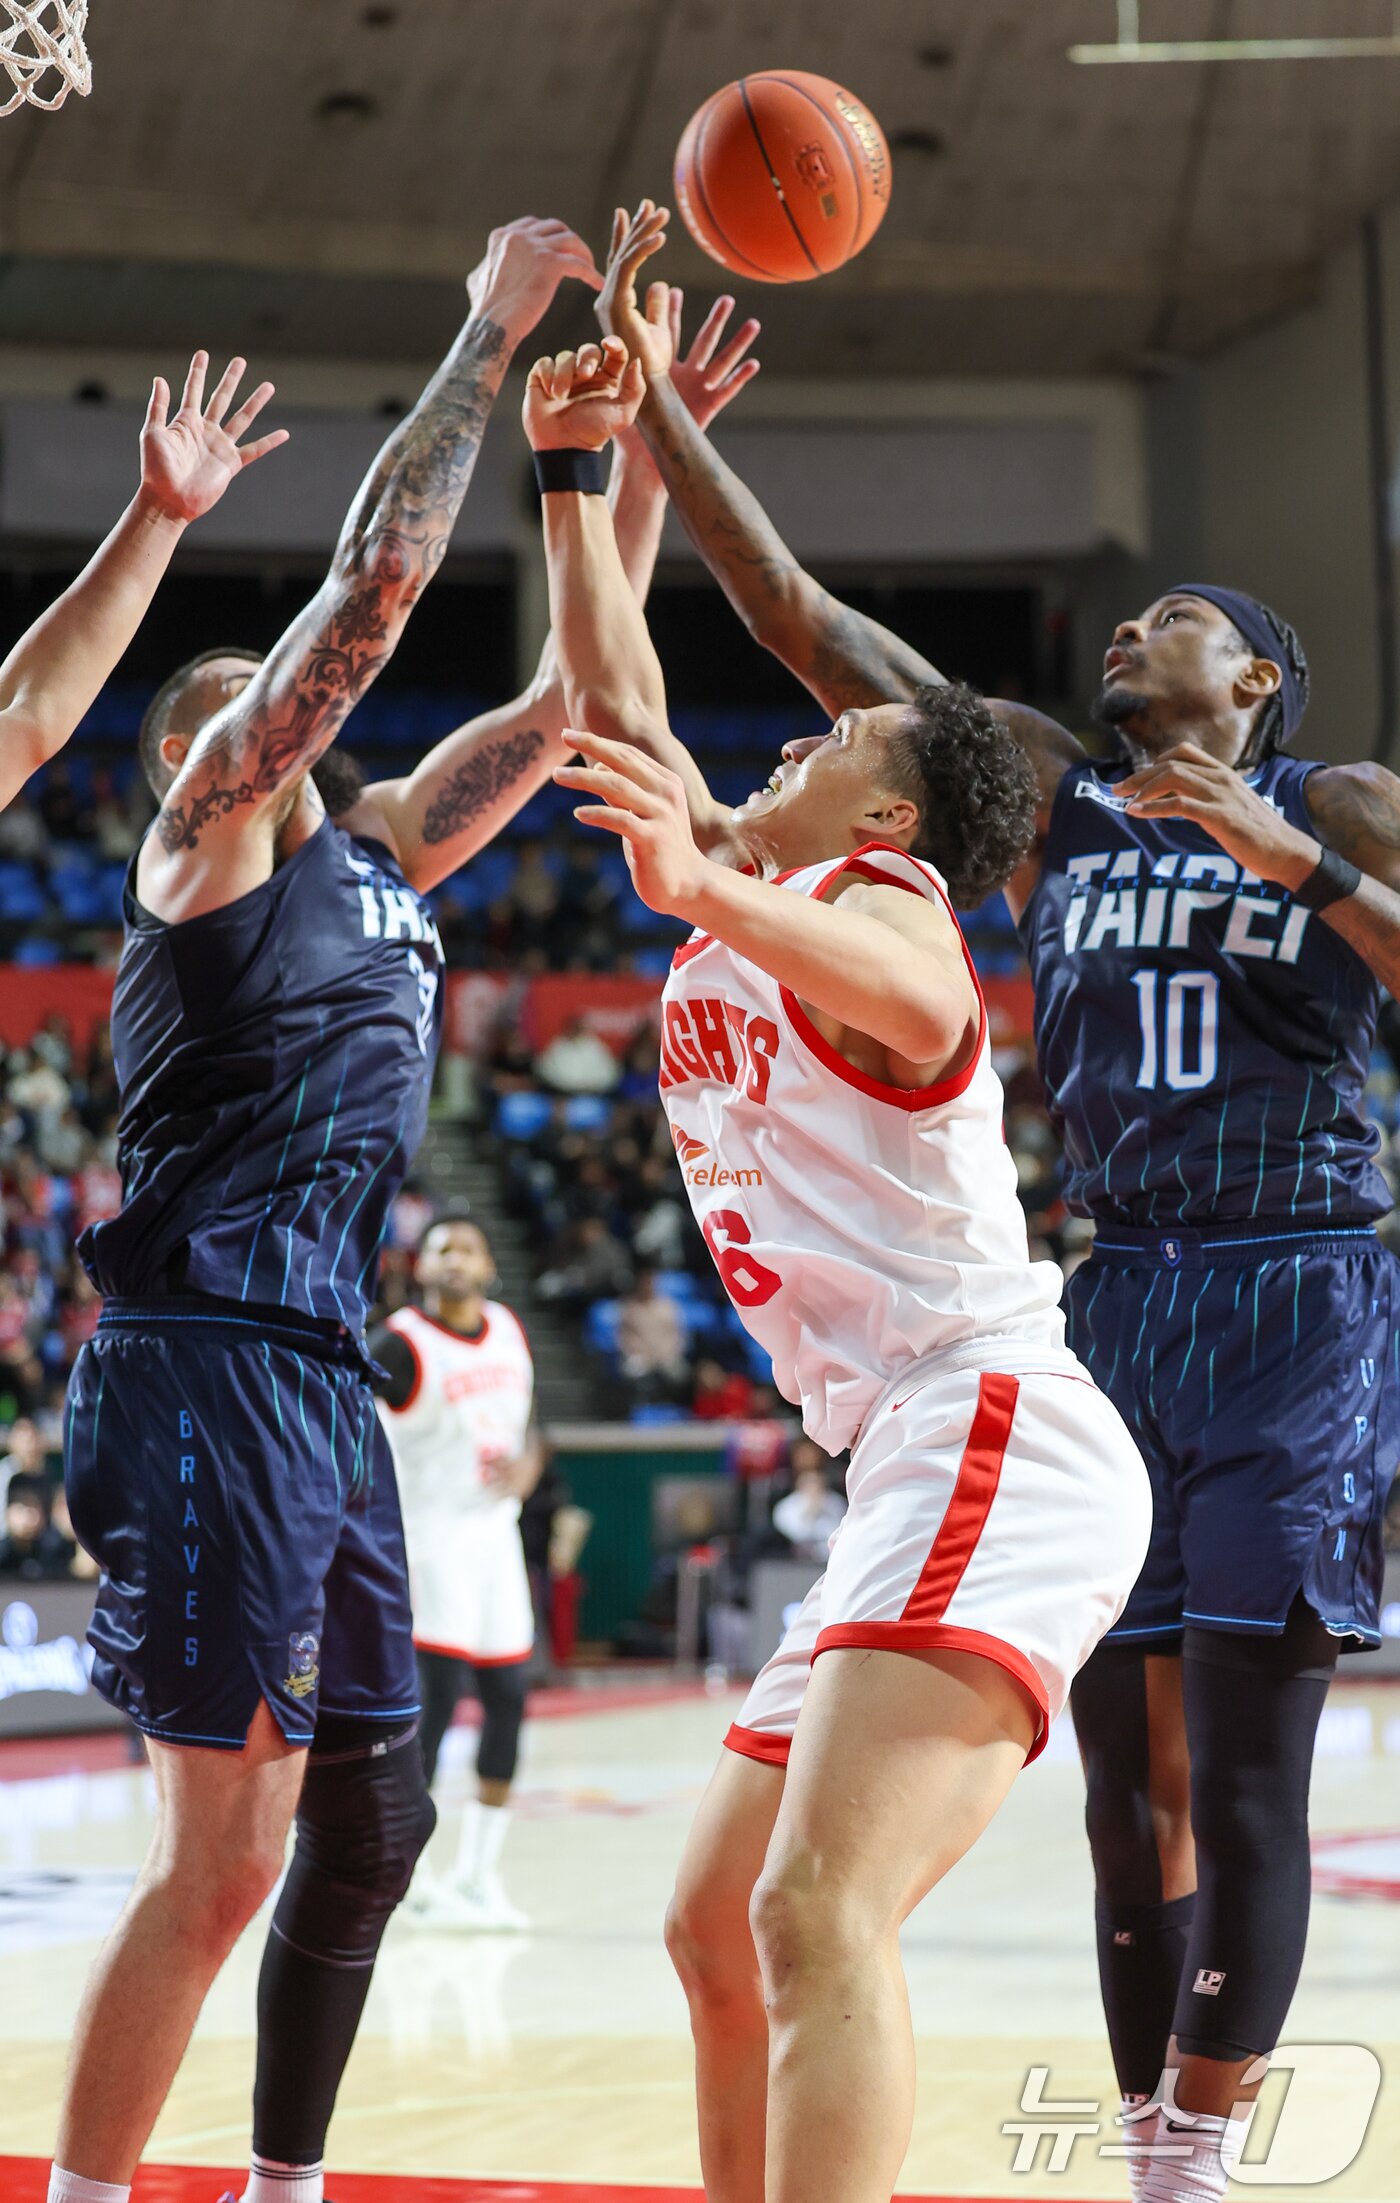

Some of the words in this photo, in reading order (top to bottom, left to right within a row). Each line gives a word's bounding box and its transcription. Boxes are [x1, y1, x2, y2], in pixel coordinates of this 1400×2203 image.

[1064, 849, 1311, 964] TAIPEI
[1184, 878, 1291, 902] BRAVE
[1129, 968, 1220, 1091] 10
[702, 1209, 783, 1307] 6
[179, 1409, 199, 1667] BRAVES
